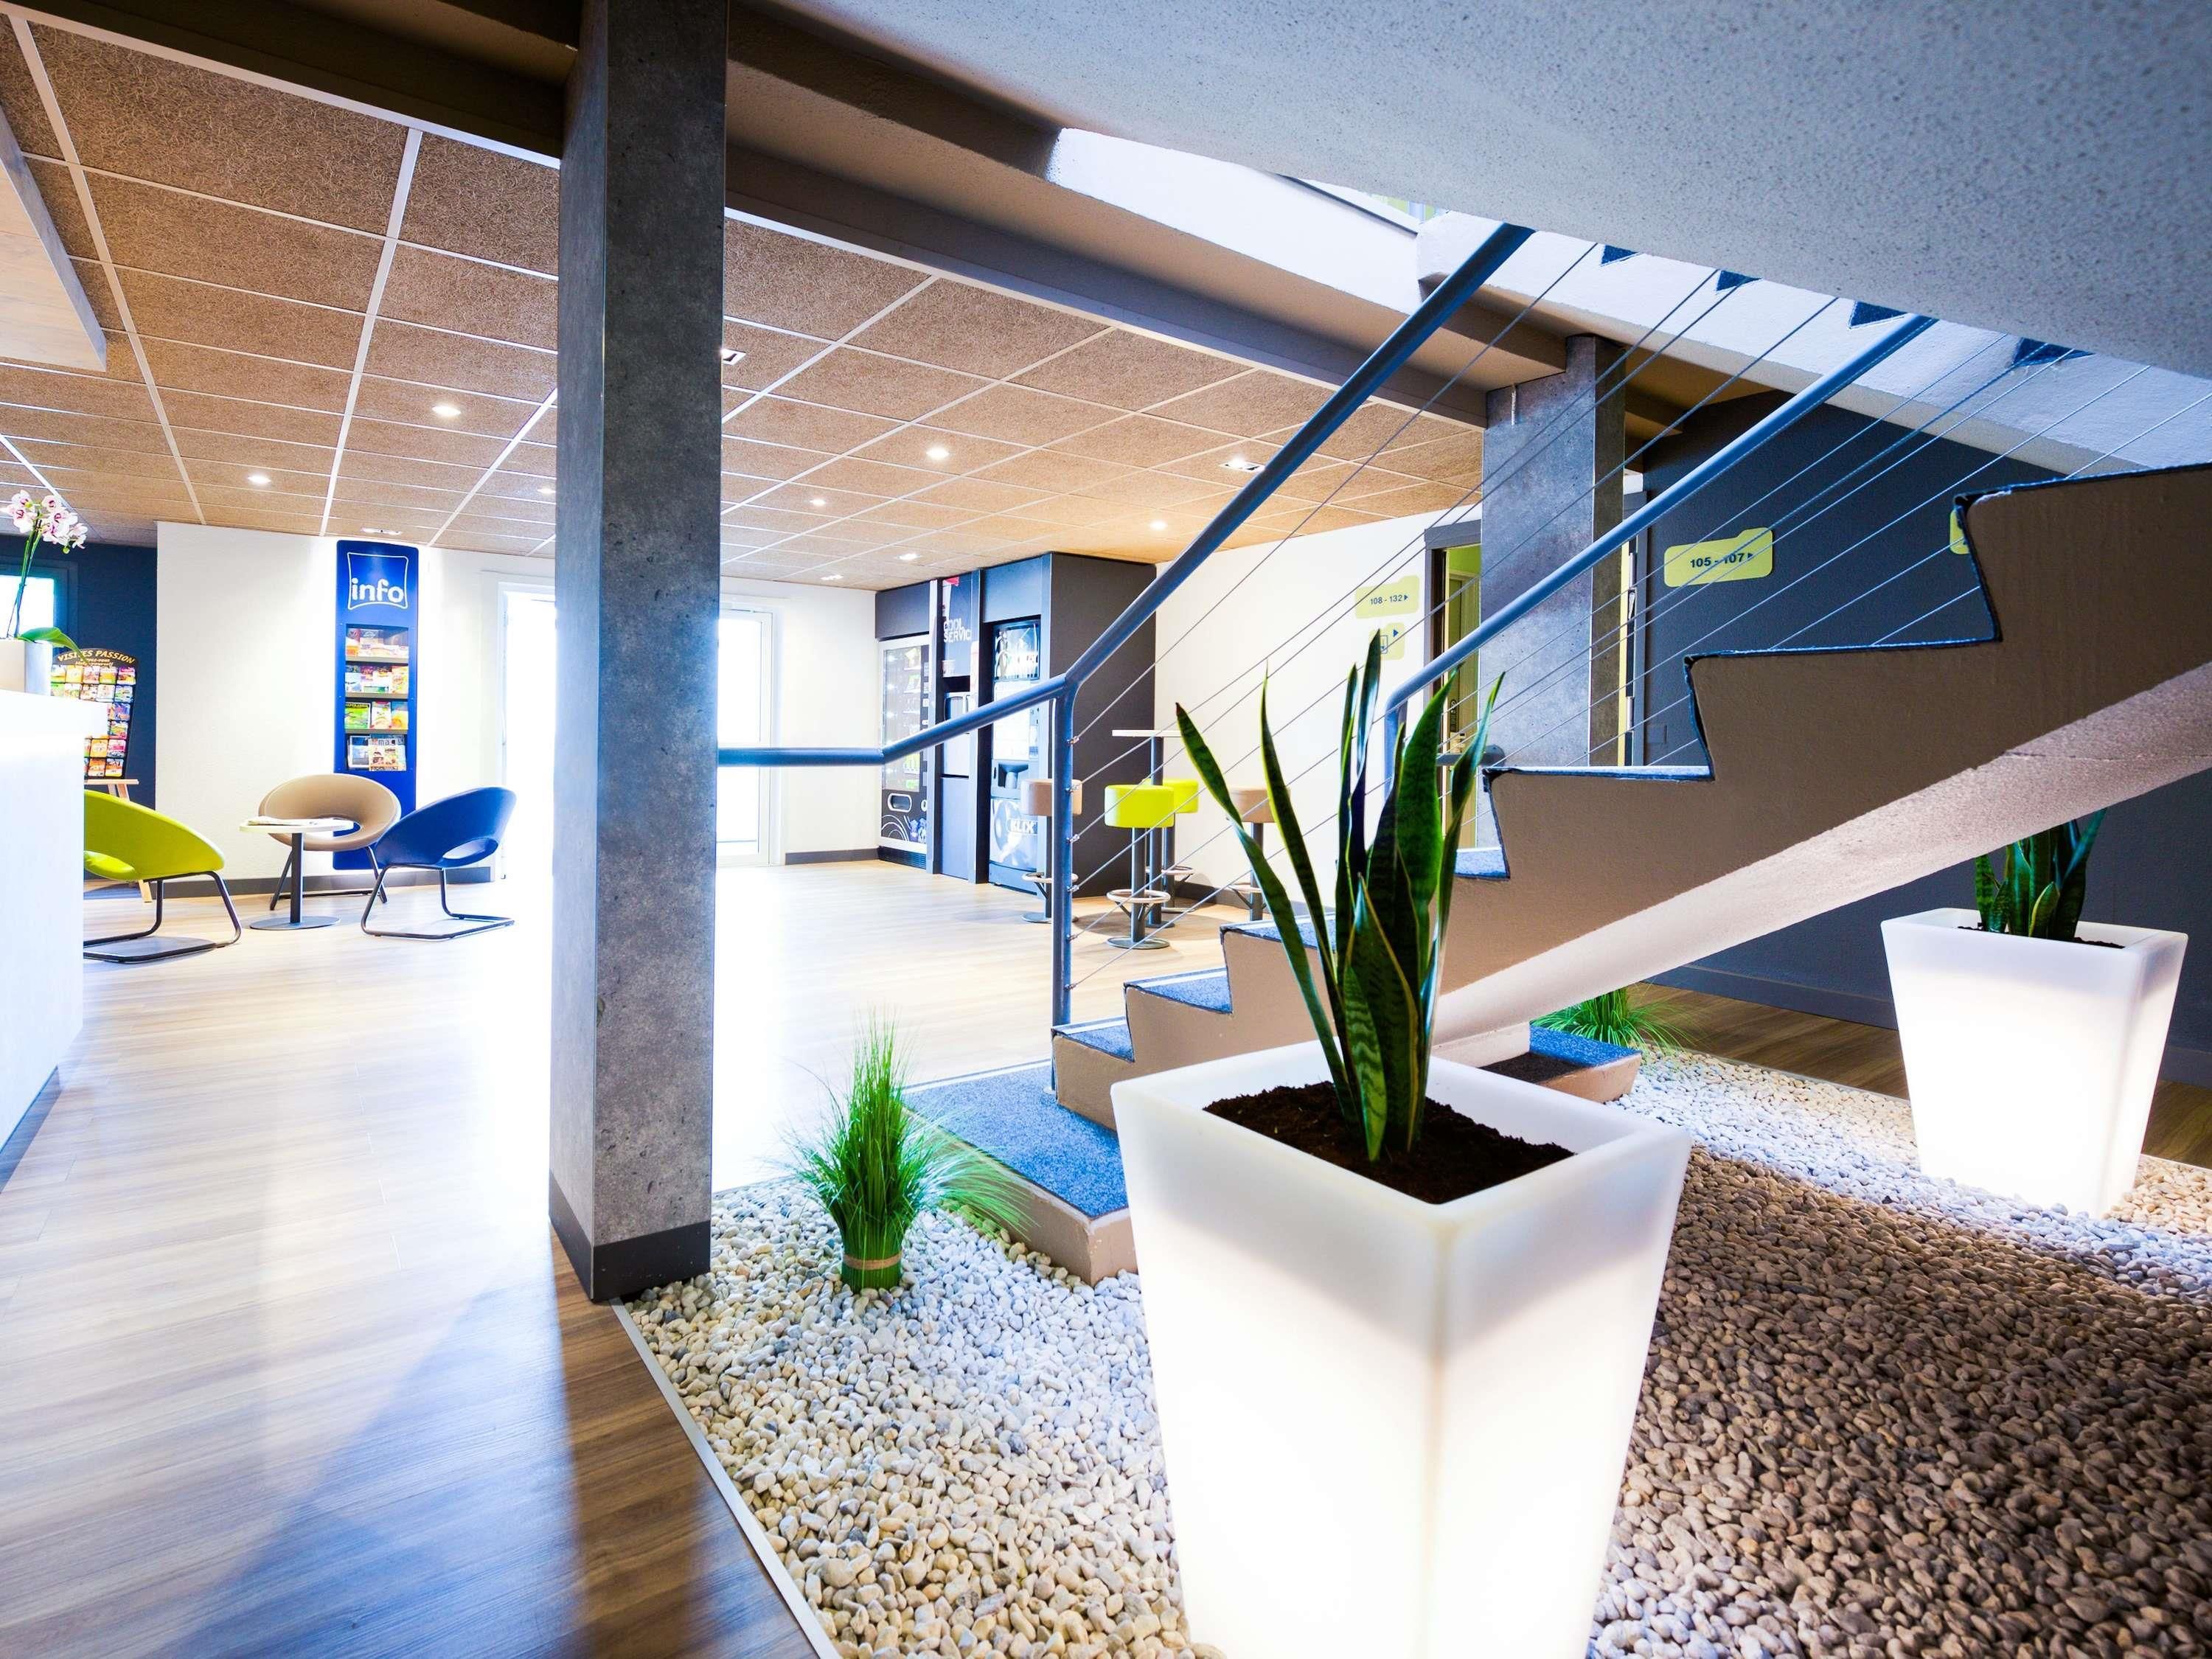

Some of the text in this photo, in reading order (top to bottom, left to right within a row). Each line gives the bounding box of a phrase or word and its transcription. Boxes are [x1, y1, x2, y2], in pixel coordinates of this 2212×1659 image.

[1690, 557, 1711, 568] 105
[1724, 553, 1745, 564] 107
[351, 577, 404, 603] info
[1370, 597, 1383, 605] 108
[1389, 594, 1402, 602] 132
[943, 618, 964, 631] COOL
[58, 650, 136, 664] VISIES PASSION
